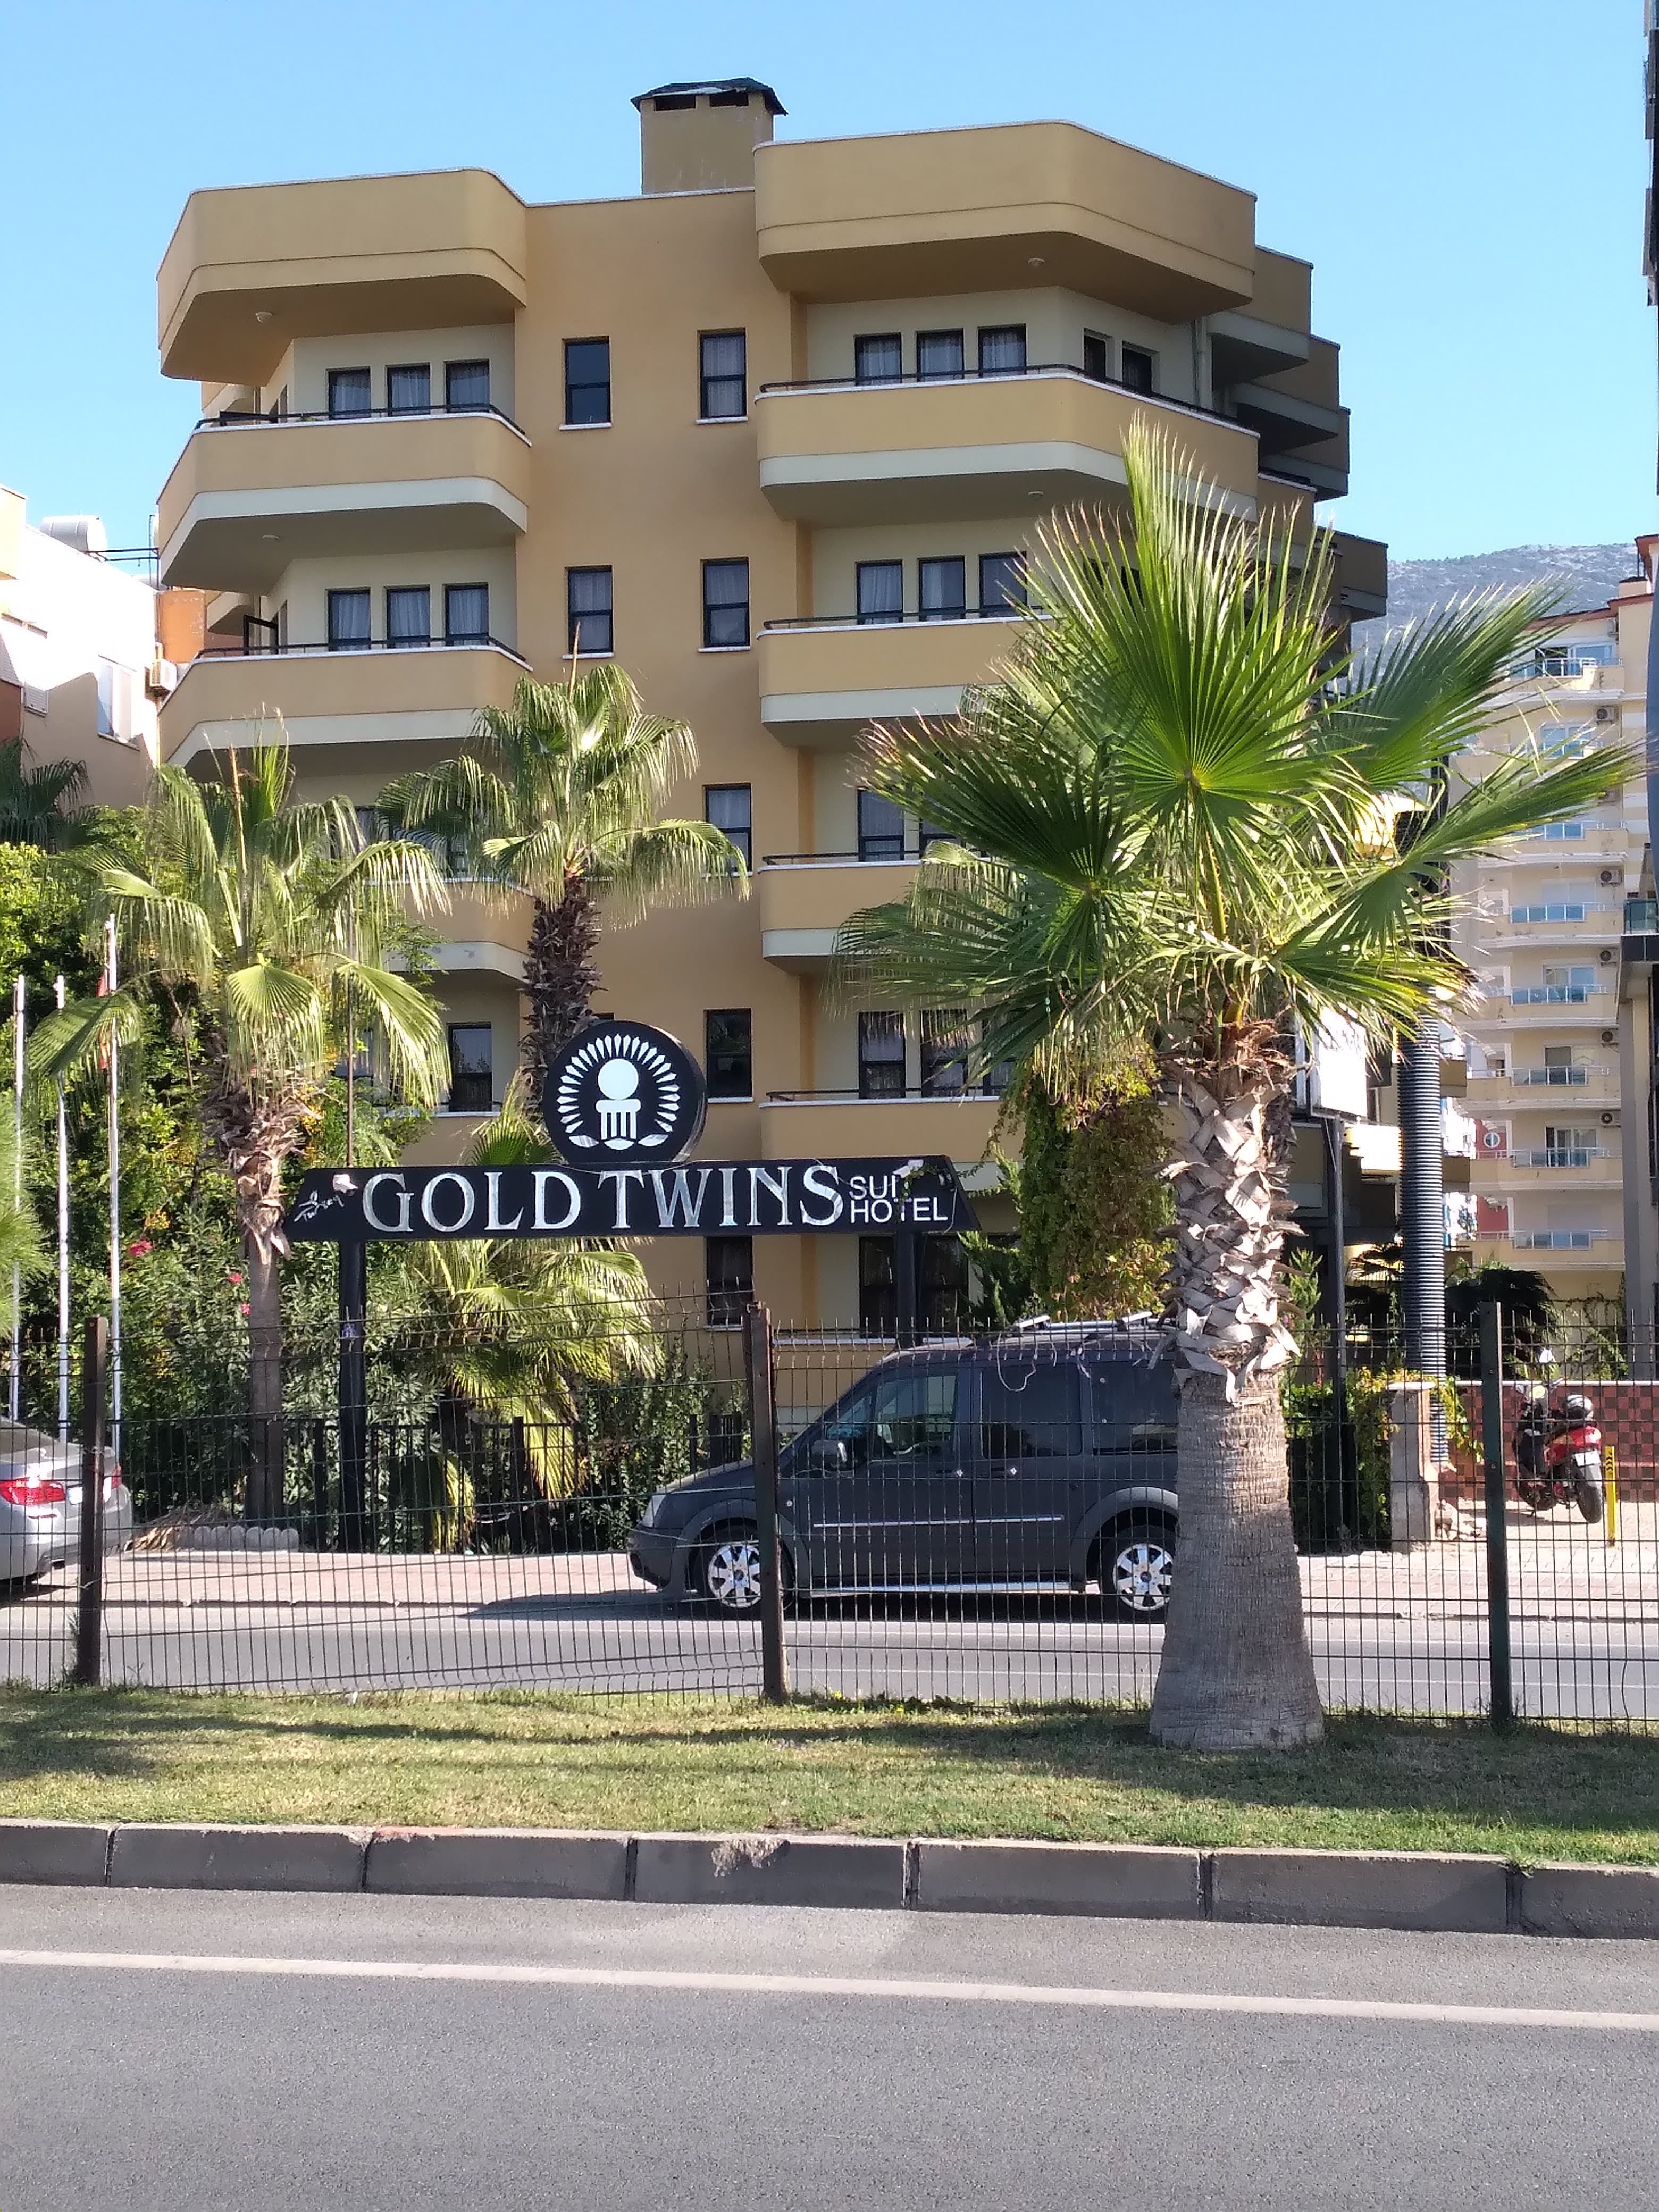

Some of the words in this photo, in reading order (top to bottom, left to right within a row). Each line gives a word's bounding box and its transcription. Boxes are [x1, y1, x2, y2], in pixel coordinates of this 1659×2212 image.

[363, 1171, 581, 1233] GOLD
[597, 1166, 843, 1229] TWINS
[849, 1175, 914, 1200] SUI
